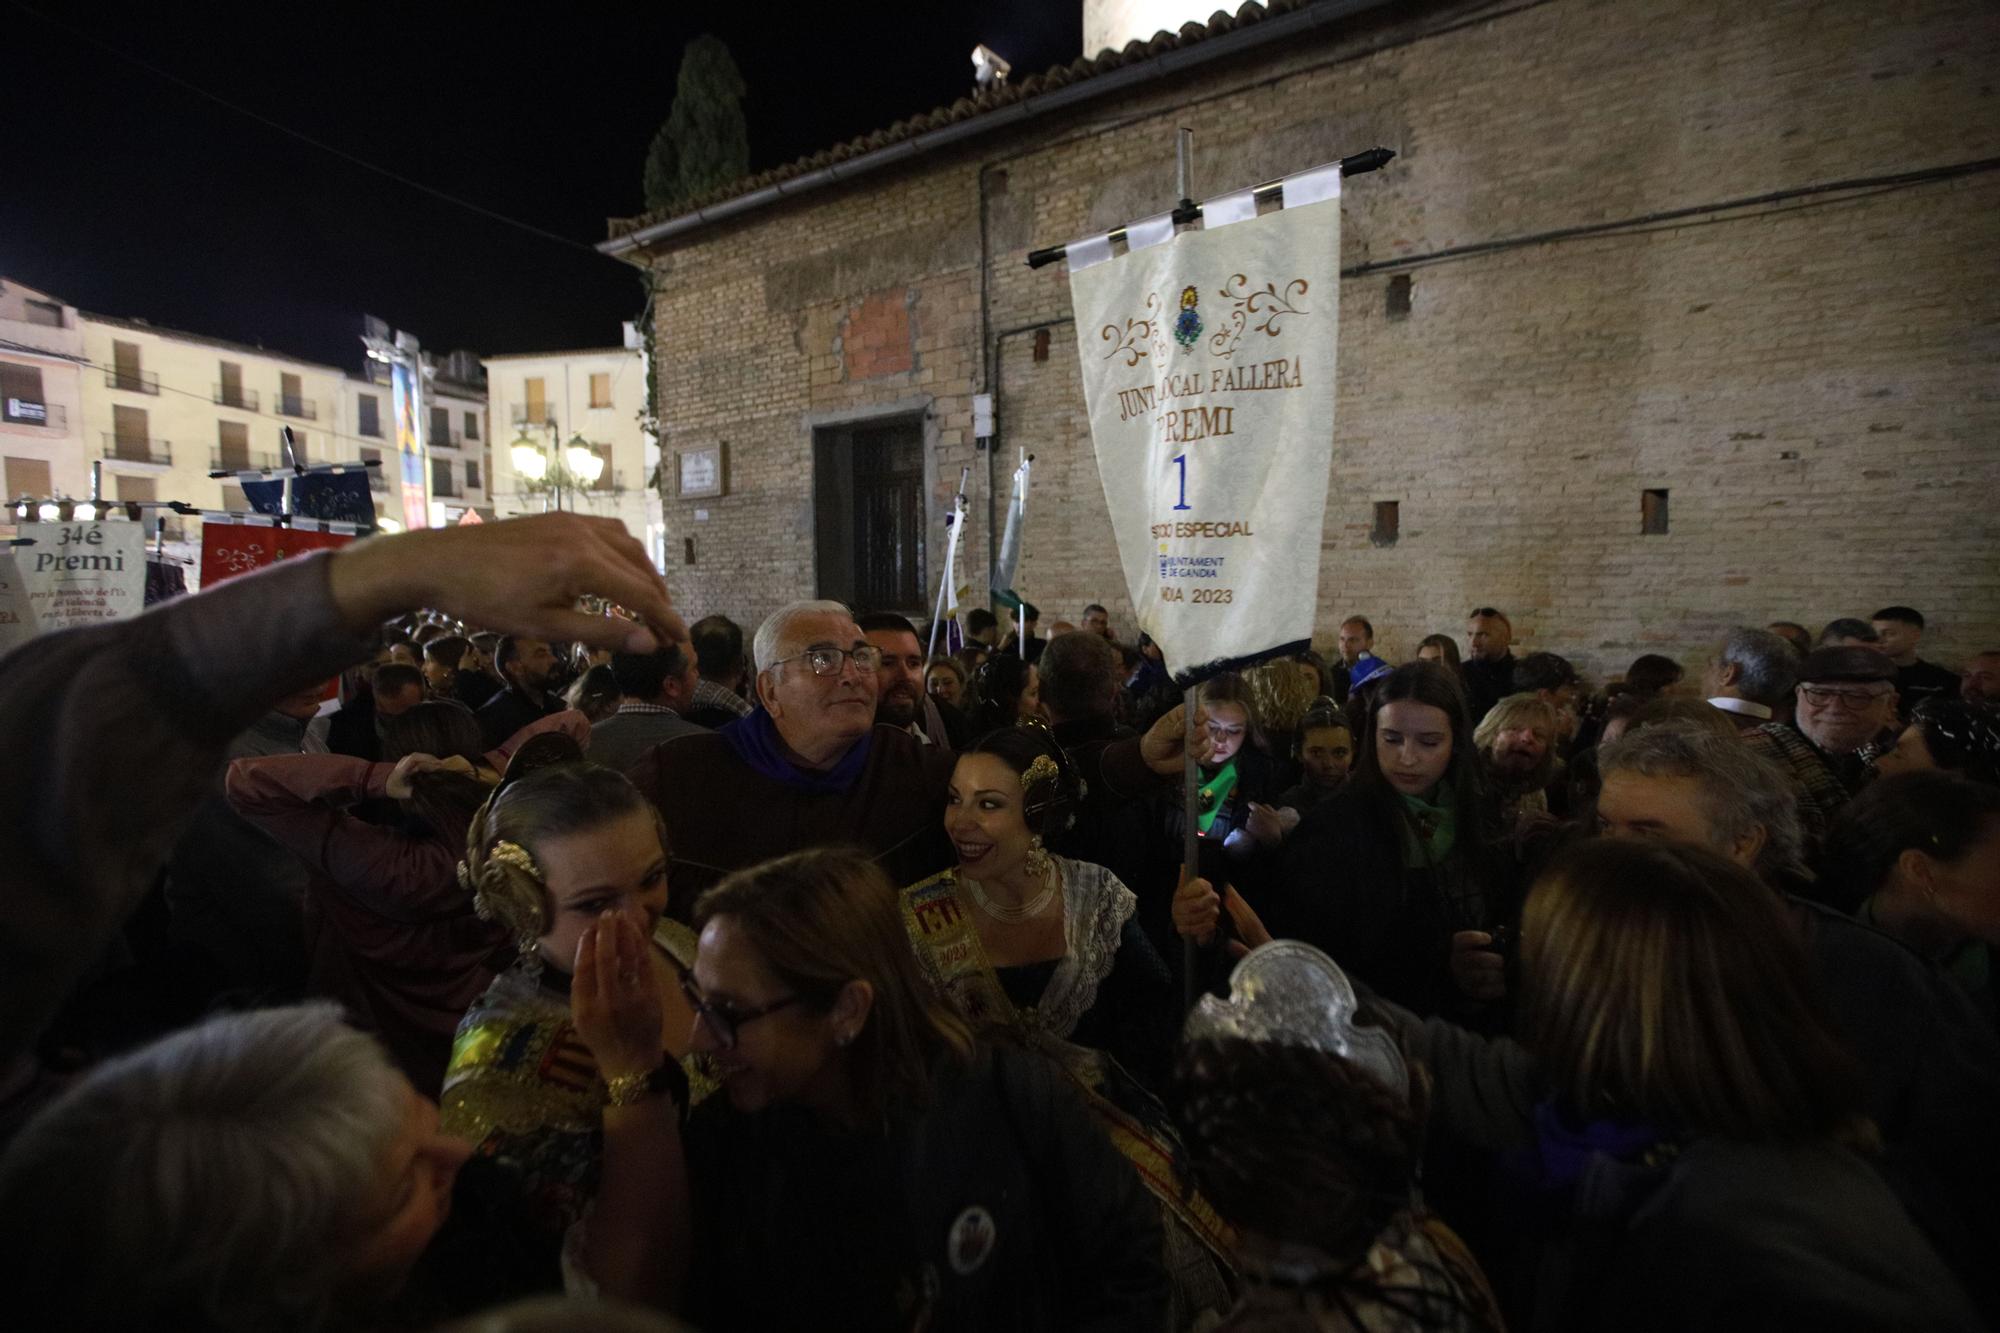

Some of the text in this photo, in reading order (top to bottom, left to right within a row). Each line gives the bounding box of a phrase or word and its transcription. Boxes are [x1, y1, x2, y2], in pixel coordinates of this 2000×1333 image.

[1211, 357, 1304, 393] FALLERA
[1172, 453, 1192, 511] 1
[57, 524, 104, 546] 34é
[1175, 522, 1254, 539] ESPECIAL
[35, 549, 125, 573] Premi
[1192, 588, 1233, 604] 2023
